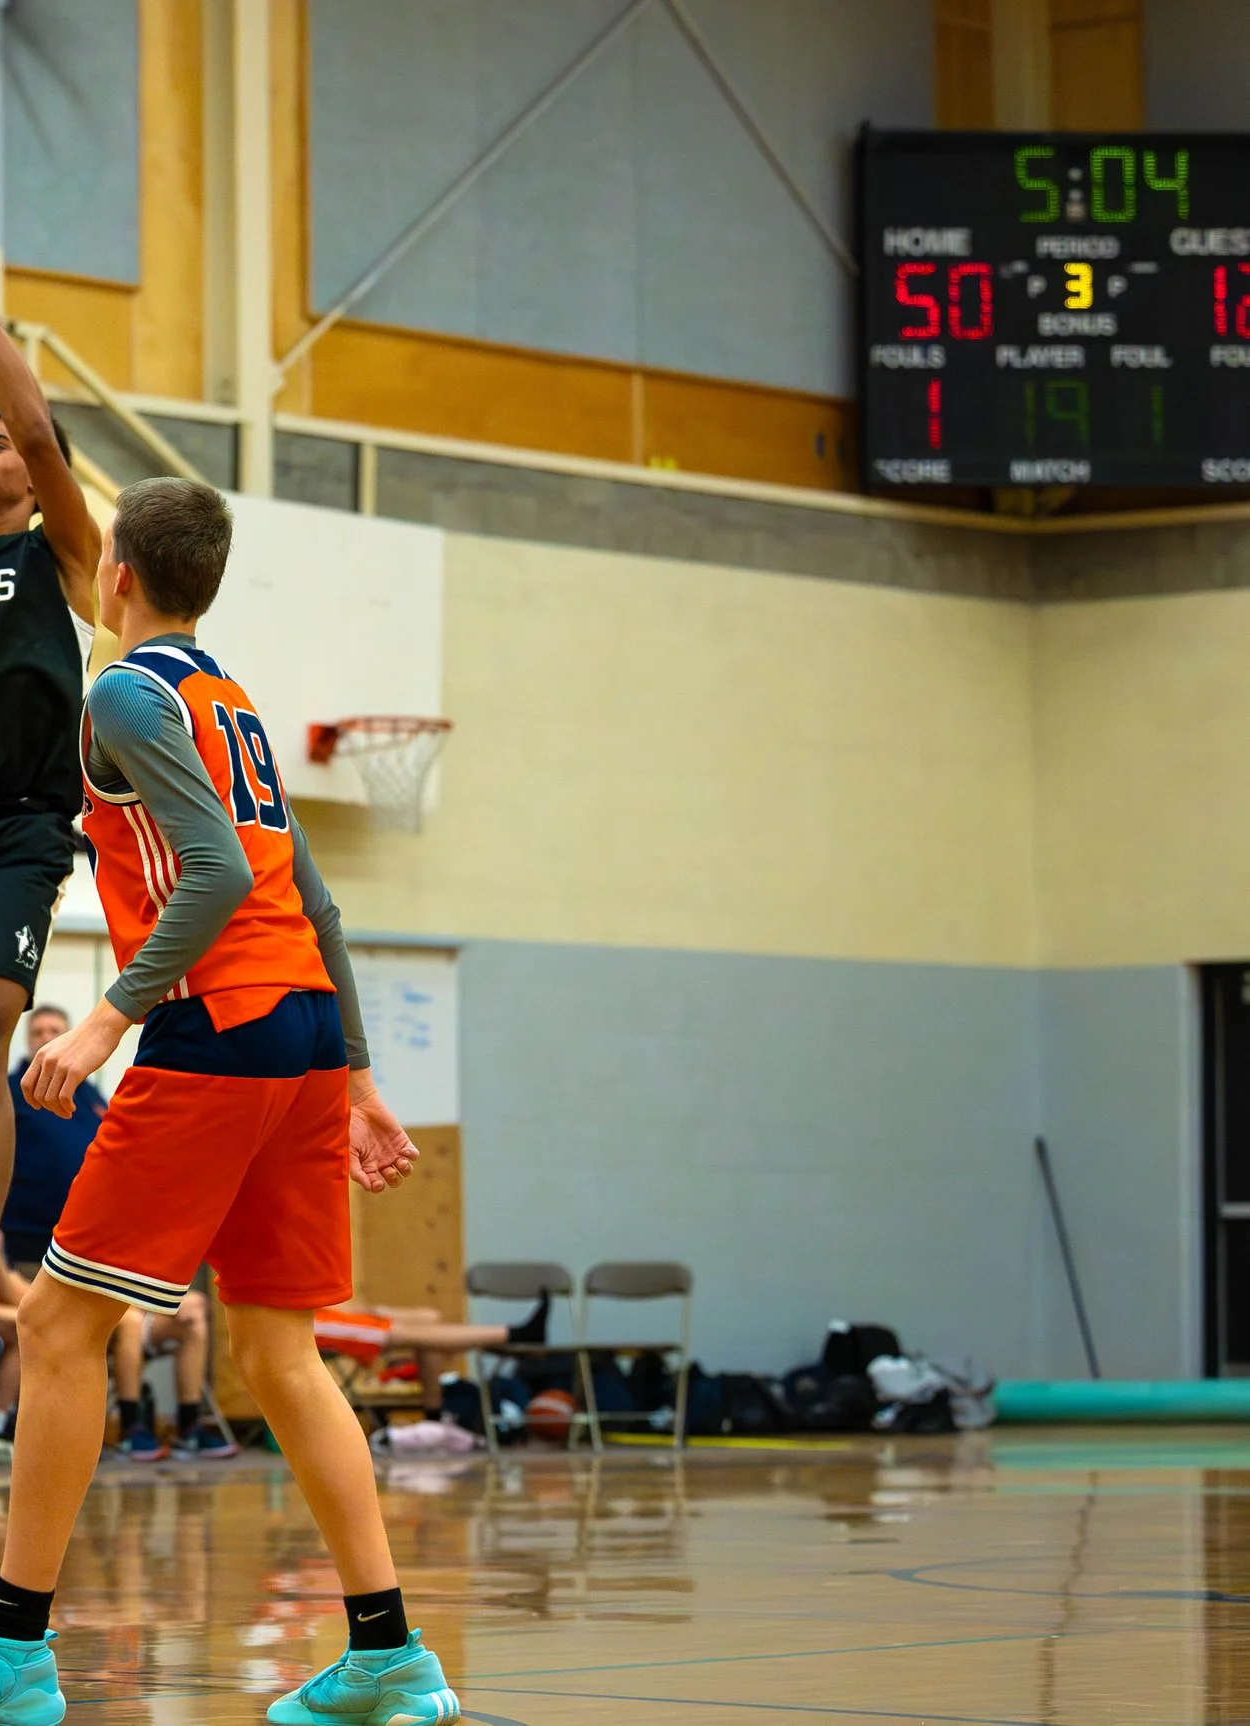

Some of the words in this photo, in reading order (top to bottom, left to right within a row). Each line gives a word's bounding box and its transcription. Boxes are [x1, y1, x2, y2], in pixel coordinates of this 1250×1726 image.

[1014, 145, 1190, 222] 5:04
[882, 227, 972, 256] HOME
[1035, 236, 1121, 259] PERIOD
[895, 262, 994, 340] 50
[1064, 262, 1093, 309] 3
[1037, 312, 1118, 337] BONUS
[870, 344, 947, 369] FOULS
[995, 344, 1086, 369] PLAYER
[928, 378, 942, 449] 1
[1024, 379, 1090, 446] 19
[1010, 458, 1092, 483] MATCH
[211, 700, 290, 834] 19
